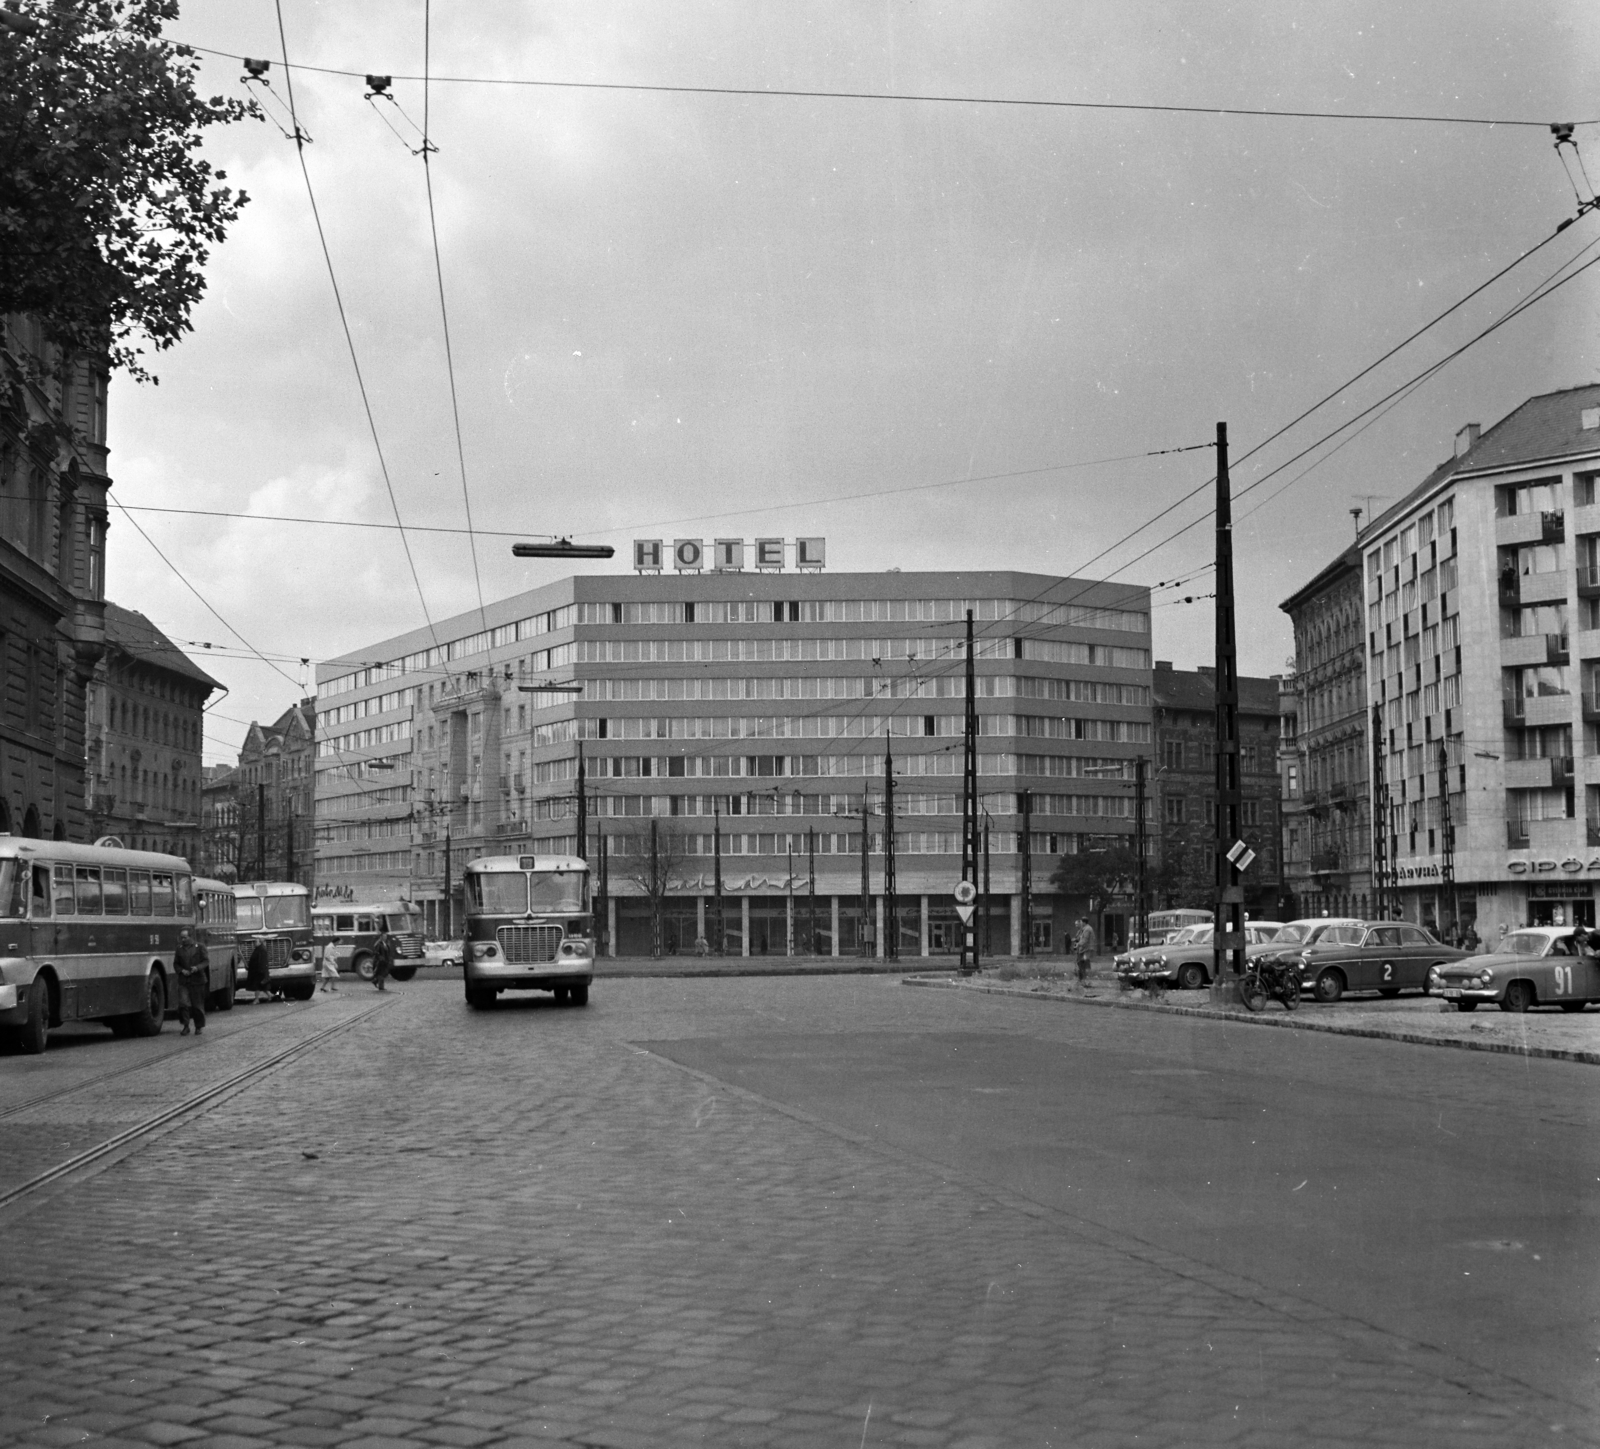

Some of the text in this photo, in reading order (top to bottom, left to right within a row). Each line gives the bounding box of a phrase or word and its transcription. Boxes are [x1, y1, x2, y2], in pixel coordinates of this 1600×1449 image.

[637, 541, 822, 565] HOTEL
[1384, 964, 1392, 981] 2
[1554, 966, 1573, 995] 91
